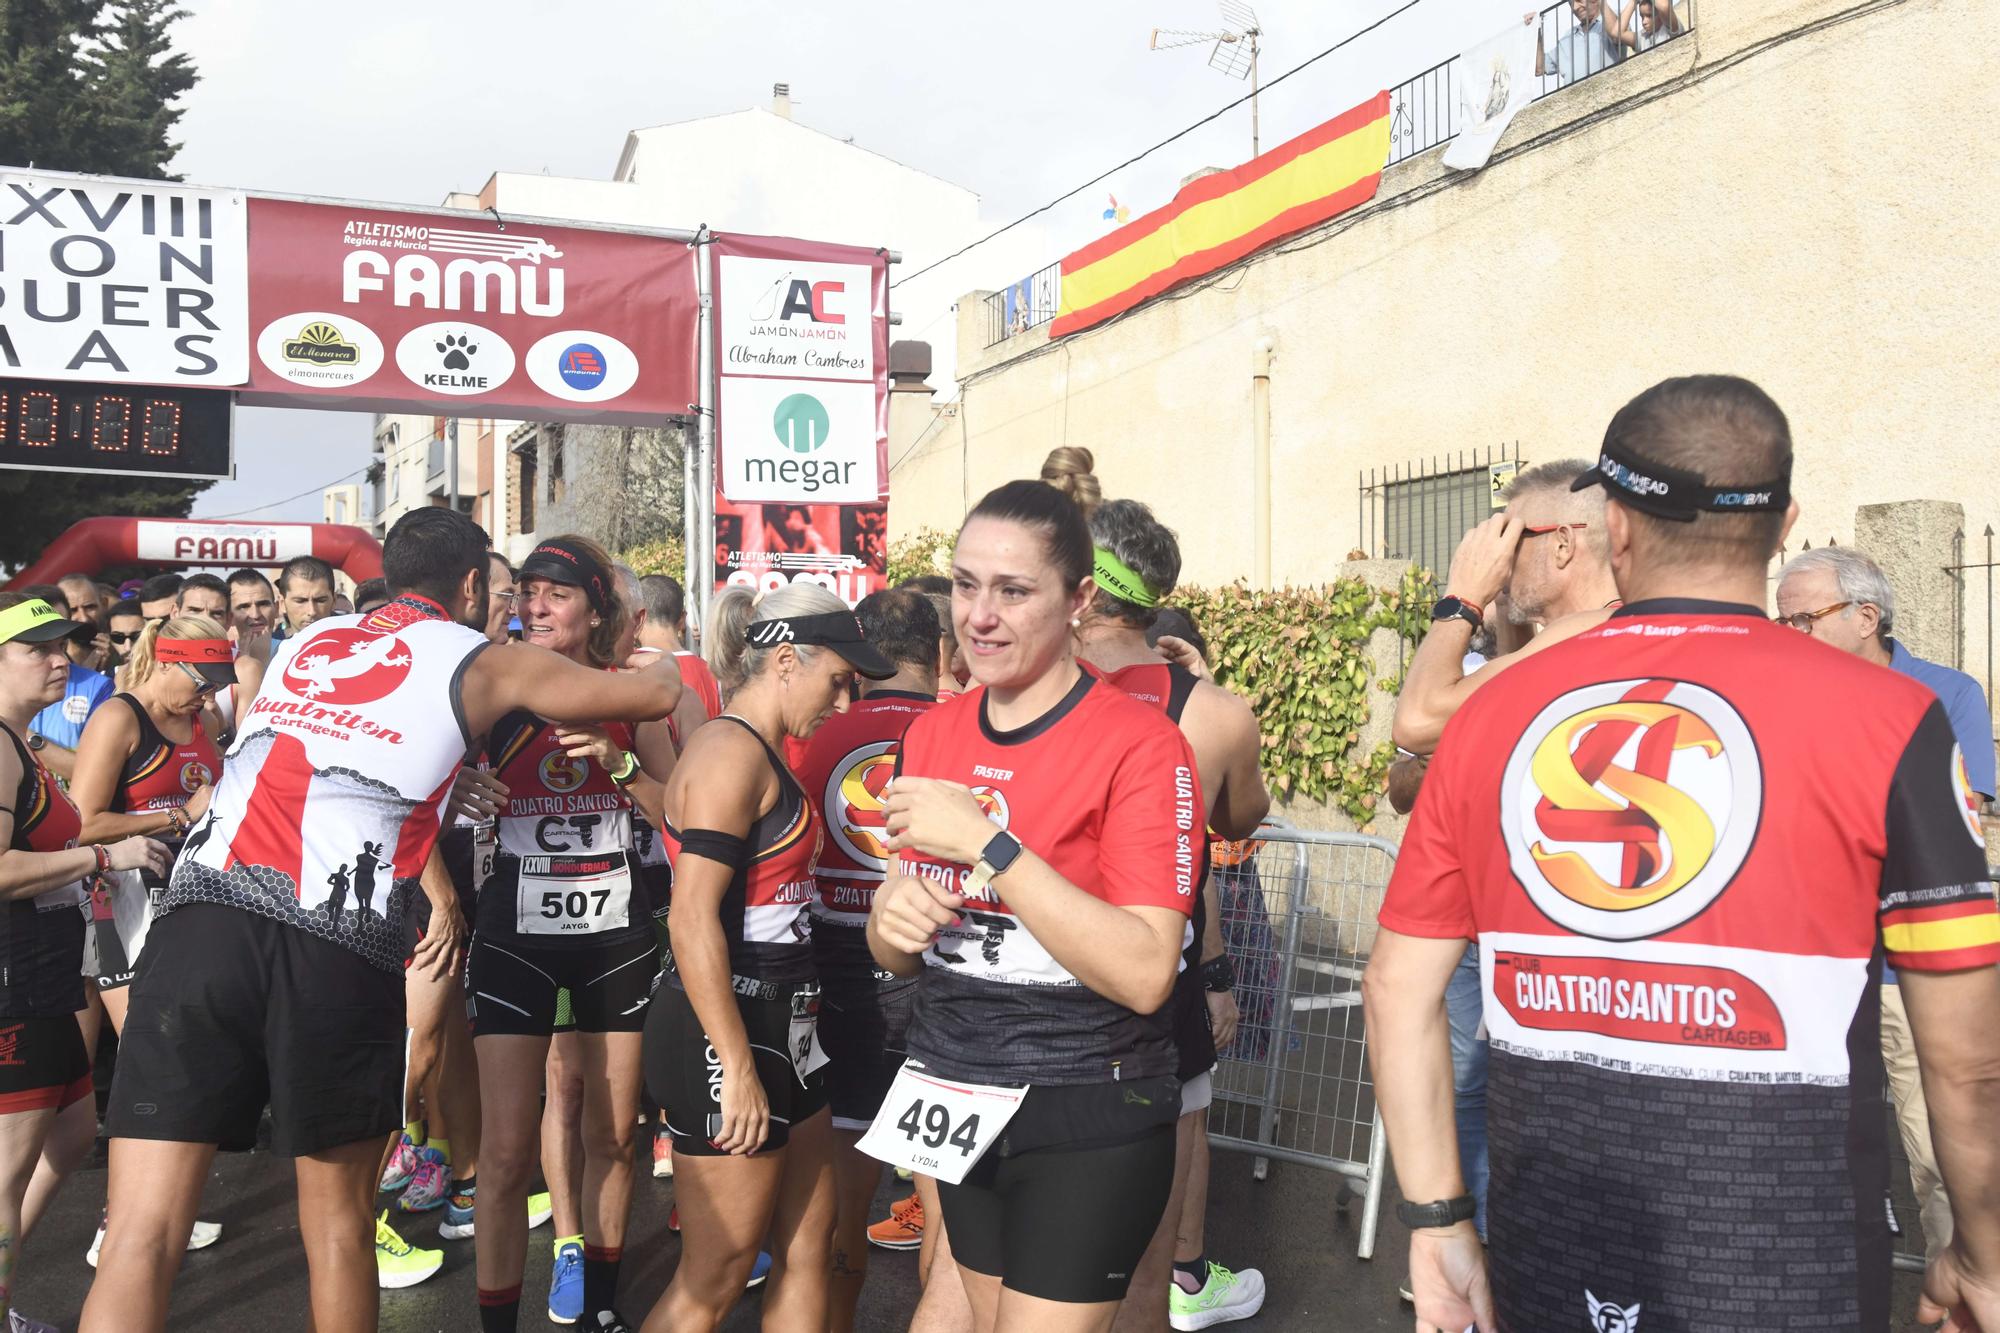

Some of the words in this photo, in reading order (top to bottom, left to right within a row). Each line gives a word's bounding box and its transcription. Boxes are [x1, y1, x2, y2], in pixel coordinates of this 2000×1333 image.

[344, 220, 428, 241] ATLETISMO
[344, 236, 378, 249] Región
[379, 239, 391, 247] de
[394, 240, 428, 250] Murcia
[343, 250, 564, 317] FAMU
[729, 345, 797, 366] Abraham
[804, 349, 865, 369] Cambres
[288, 368, 354, 380] elmonarca.es
[424, 374, 488, 389] KELME
[745, 459, 857, 492] megar
[1628, 471, 1669, 495] AHEAD
[174, 537, 276, 559] FAMU
[727, 551, 781, 562] ATLETISMO
[247, 697, 404, 744] Runtriton
[269, 715, 350, 742] Cartagena
[973, 764, 1014, 781] FASTER
[511, 796, 563, 816] CUATRO
[567, 794, 619, 812] SANTOS
[1175, 766, 1194, 830] CUATRO
[535, 814, 602, 853] CT
[523, 856, 551, 874] XXVIII
[1175, 834, 1193, 897] SANTOS
[540, 889, 611, 919] 507
[560, 922, 590, 930] JAYGO
[1514, 957, 1541, 972] CLUB
[1515, 971, 1612, 1016] CUATRO
[1614, 979, 1737, 1028] SANTOS
[1681, 1026, 1773, 1046] CARTAGENA
[1636, 1062, 1695, 1077] CARTAGENA
[1729, 1070, 1771, 1083] CUATRO
[897, 1098, 981, 1157] 494
[911, 1153, 939, 1169] LYDIA
